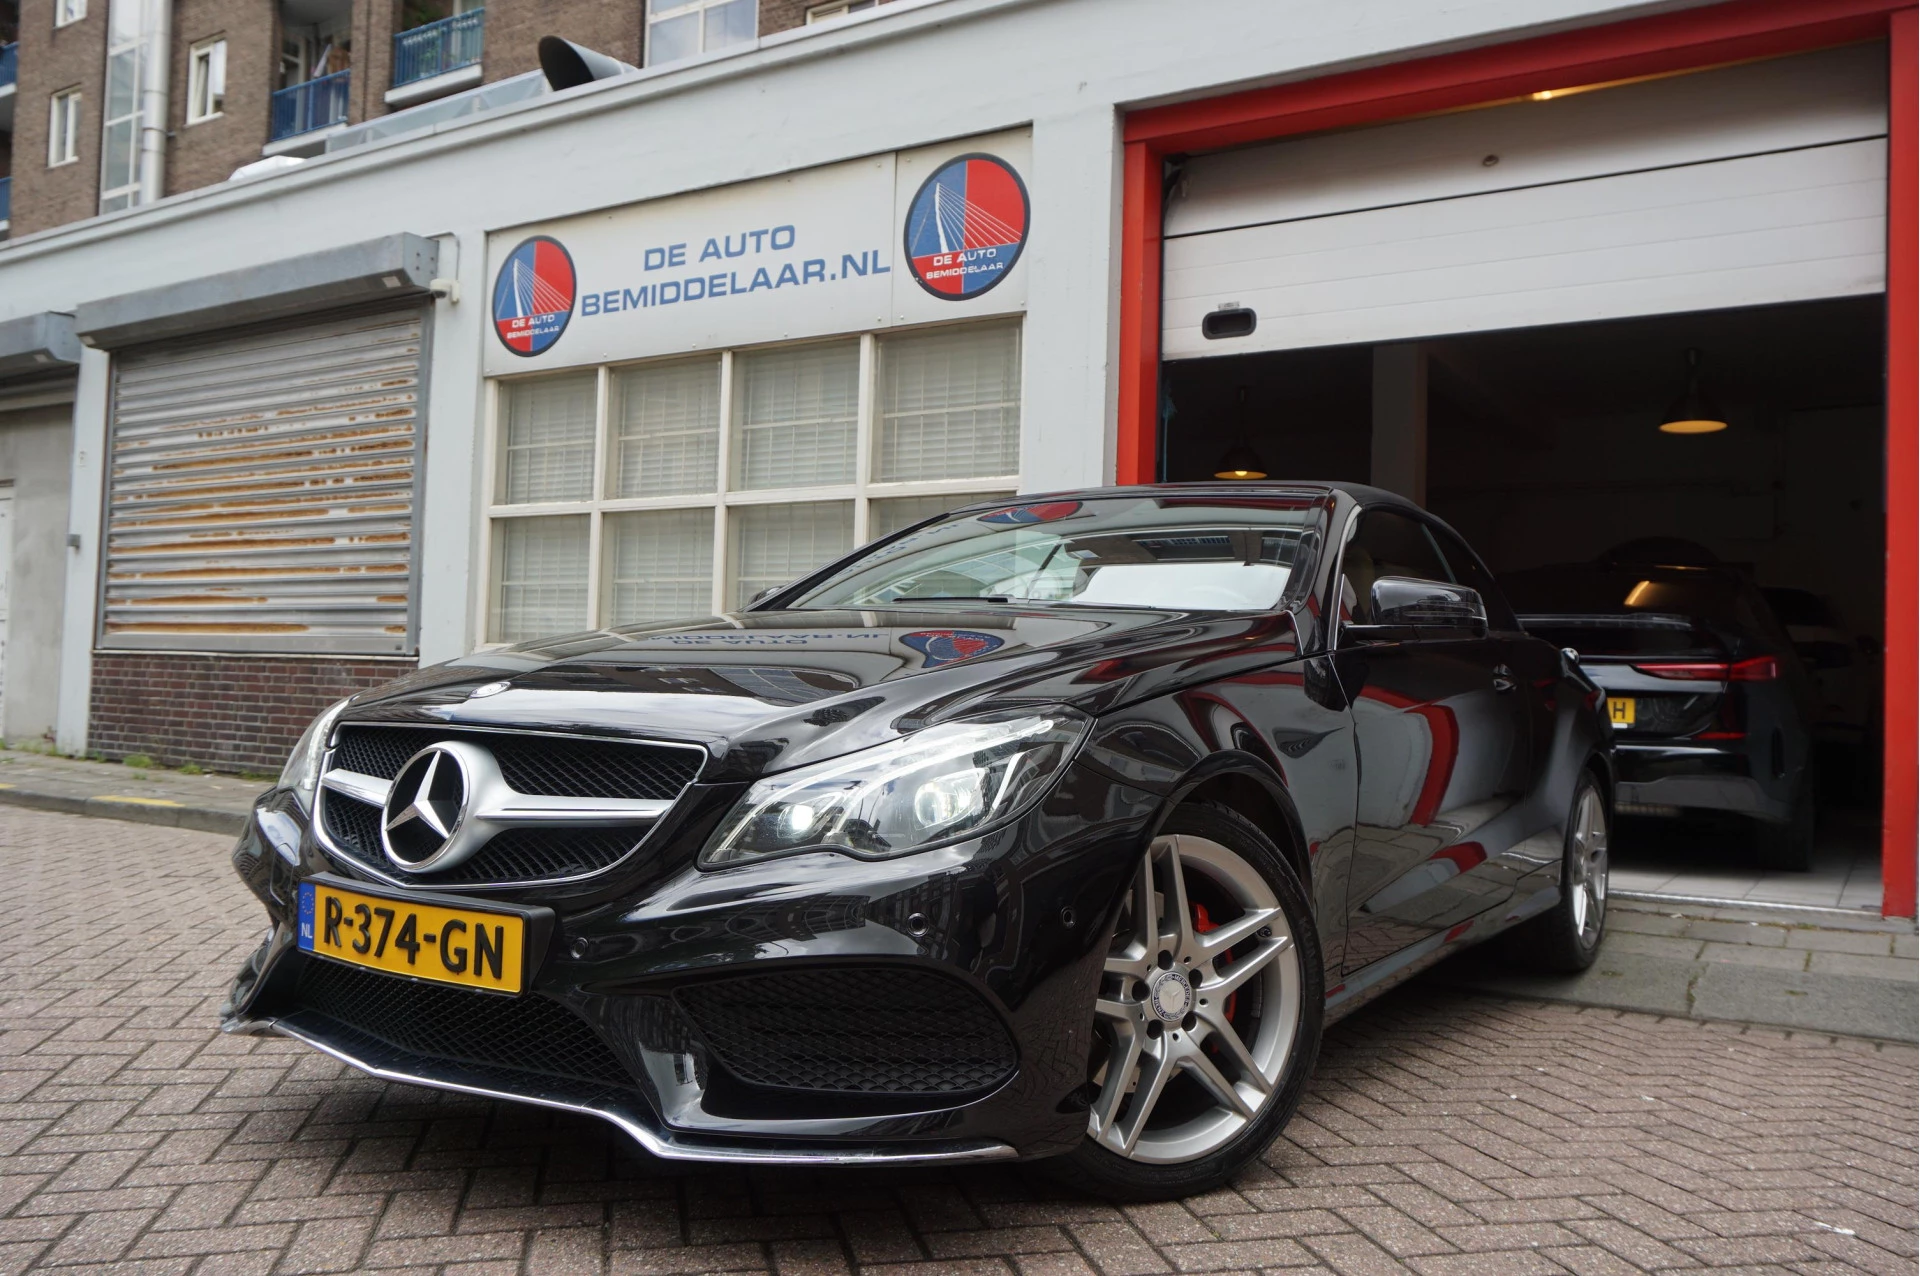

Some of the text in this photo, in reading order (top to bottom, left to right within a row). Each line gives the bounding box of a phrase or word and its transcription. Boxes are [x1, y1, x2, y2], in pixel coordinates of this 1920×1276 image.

[644, 225, 796, 271] DE AUTO
[933, 248, 997, 266] DE AUTO
[926, 262, 1004, 280] BEMIDDELAAR
[581, 249, 891, 317] BEMIDDELAAR.NL
[512, 314, 555, 328] DE AUTO
[507, 326, 559, 339] BEMIDDELAAR
[301, 922, 313, 939] NL
[324, 896, 504, 979] R-374-GN
